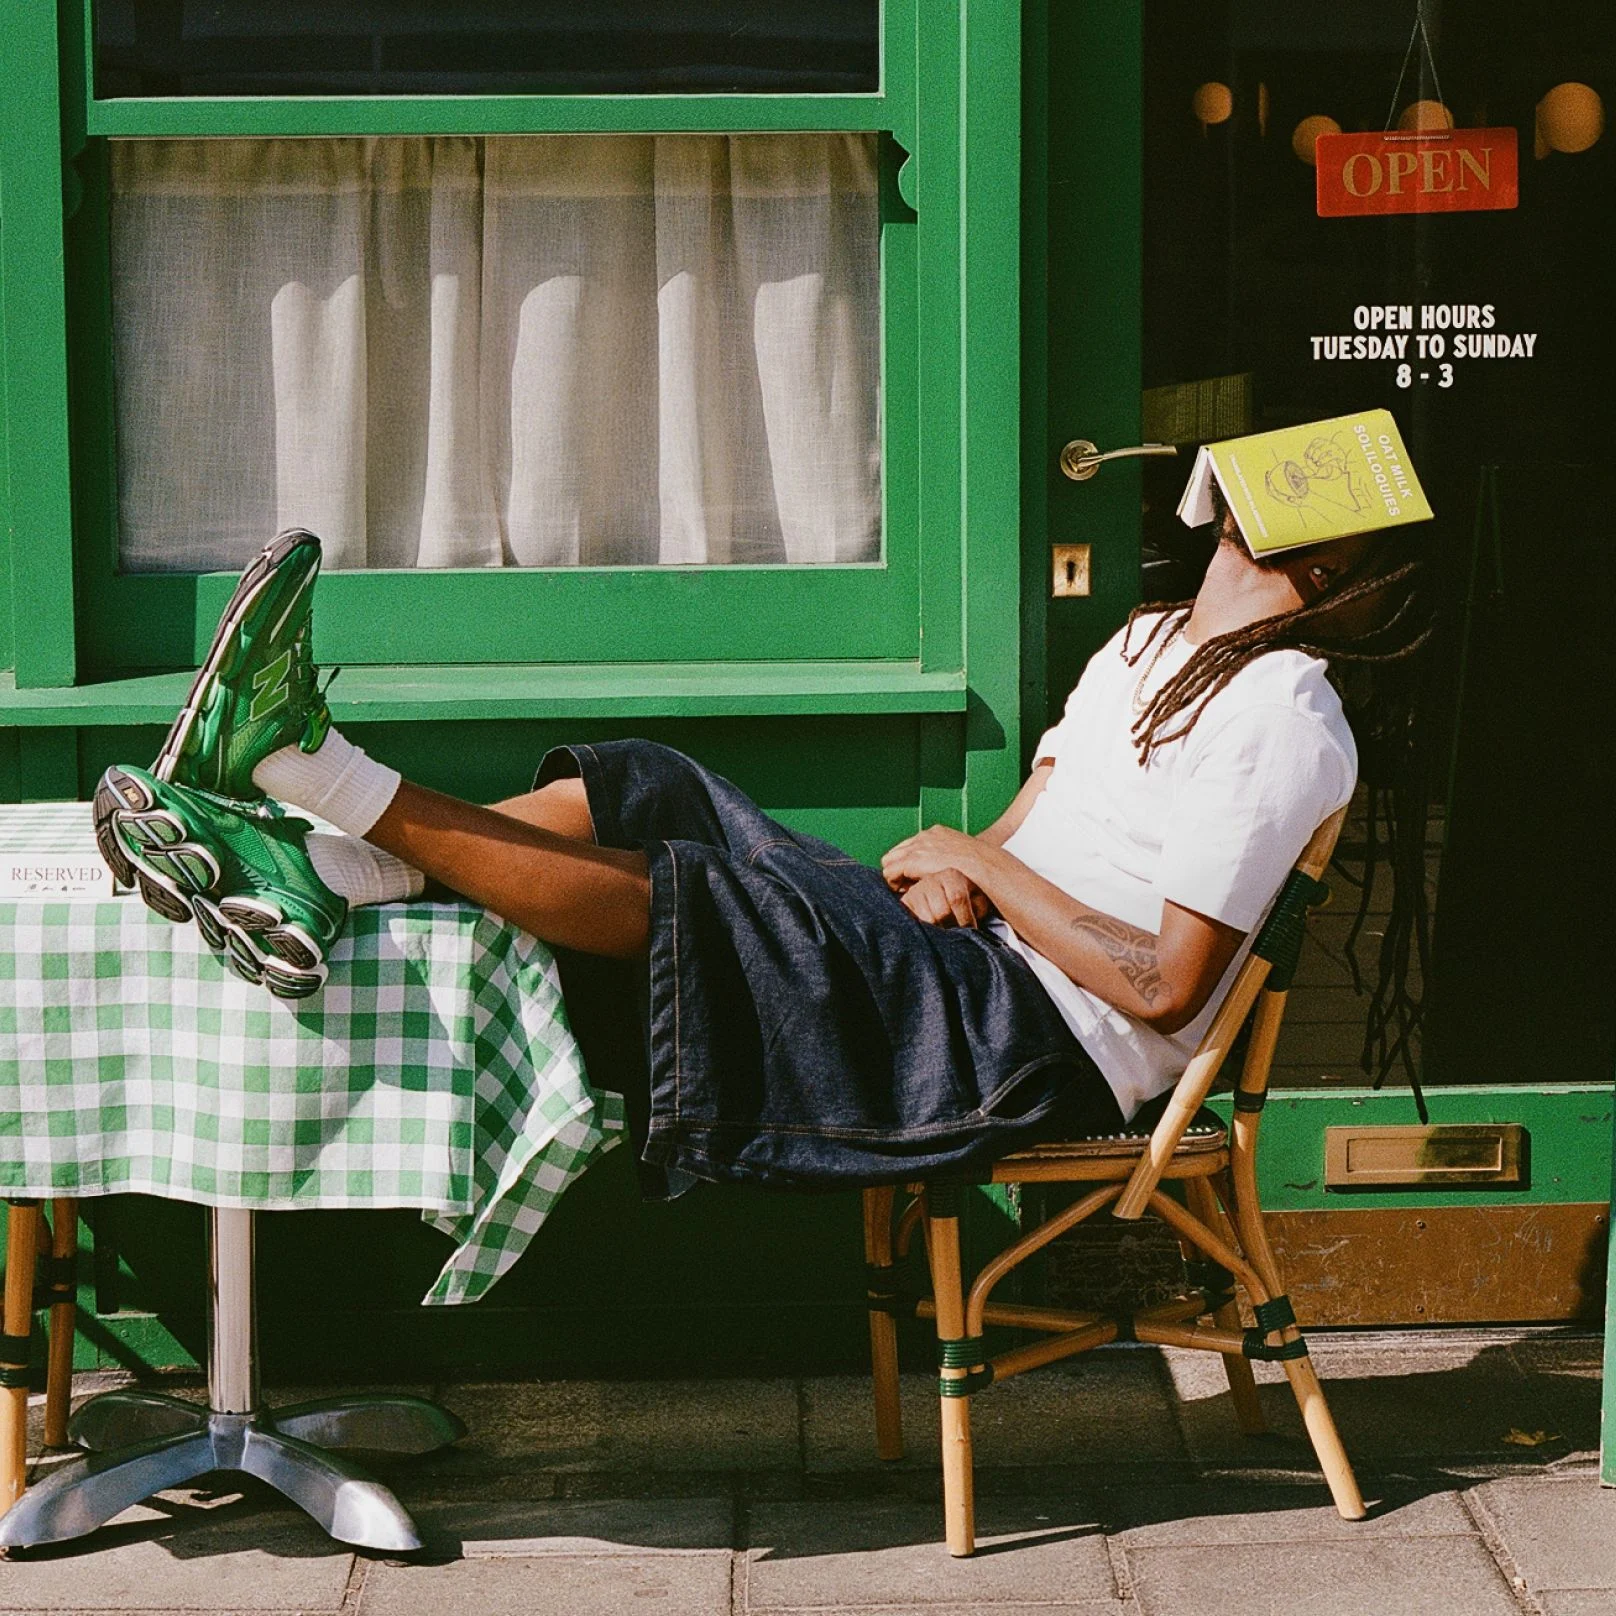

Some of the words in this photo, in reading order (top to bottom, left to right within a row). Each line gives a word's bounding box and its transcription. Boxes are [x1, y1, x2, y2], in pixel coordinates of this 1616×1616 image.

[1342, 147, 1493, 198] OPEN
[1353, 305, 1412, 330] OPEN
[1421, 304, 1496, 329] HOURS
[1310, 334, 1409, 360] TUESDAY
[1416, 335, 1445, 359] TO
[1453, 333, 1538, 359] SUNDAY
[1395, 364, 1412, 389] 8
[1437, 363, 1454, 389] 3
[1353, 424, 1401, 516] SOLILOQUIES
[1378, 434, 1398, 461] OAT
[1390, 464, 1413, 499] MILK
[11, 866, 103, 882] RESERVED
